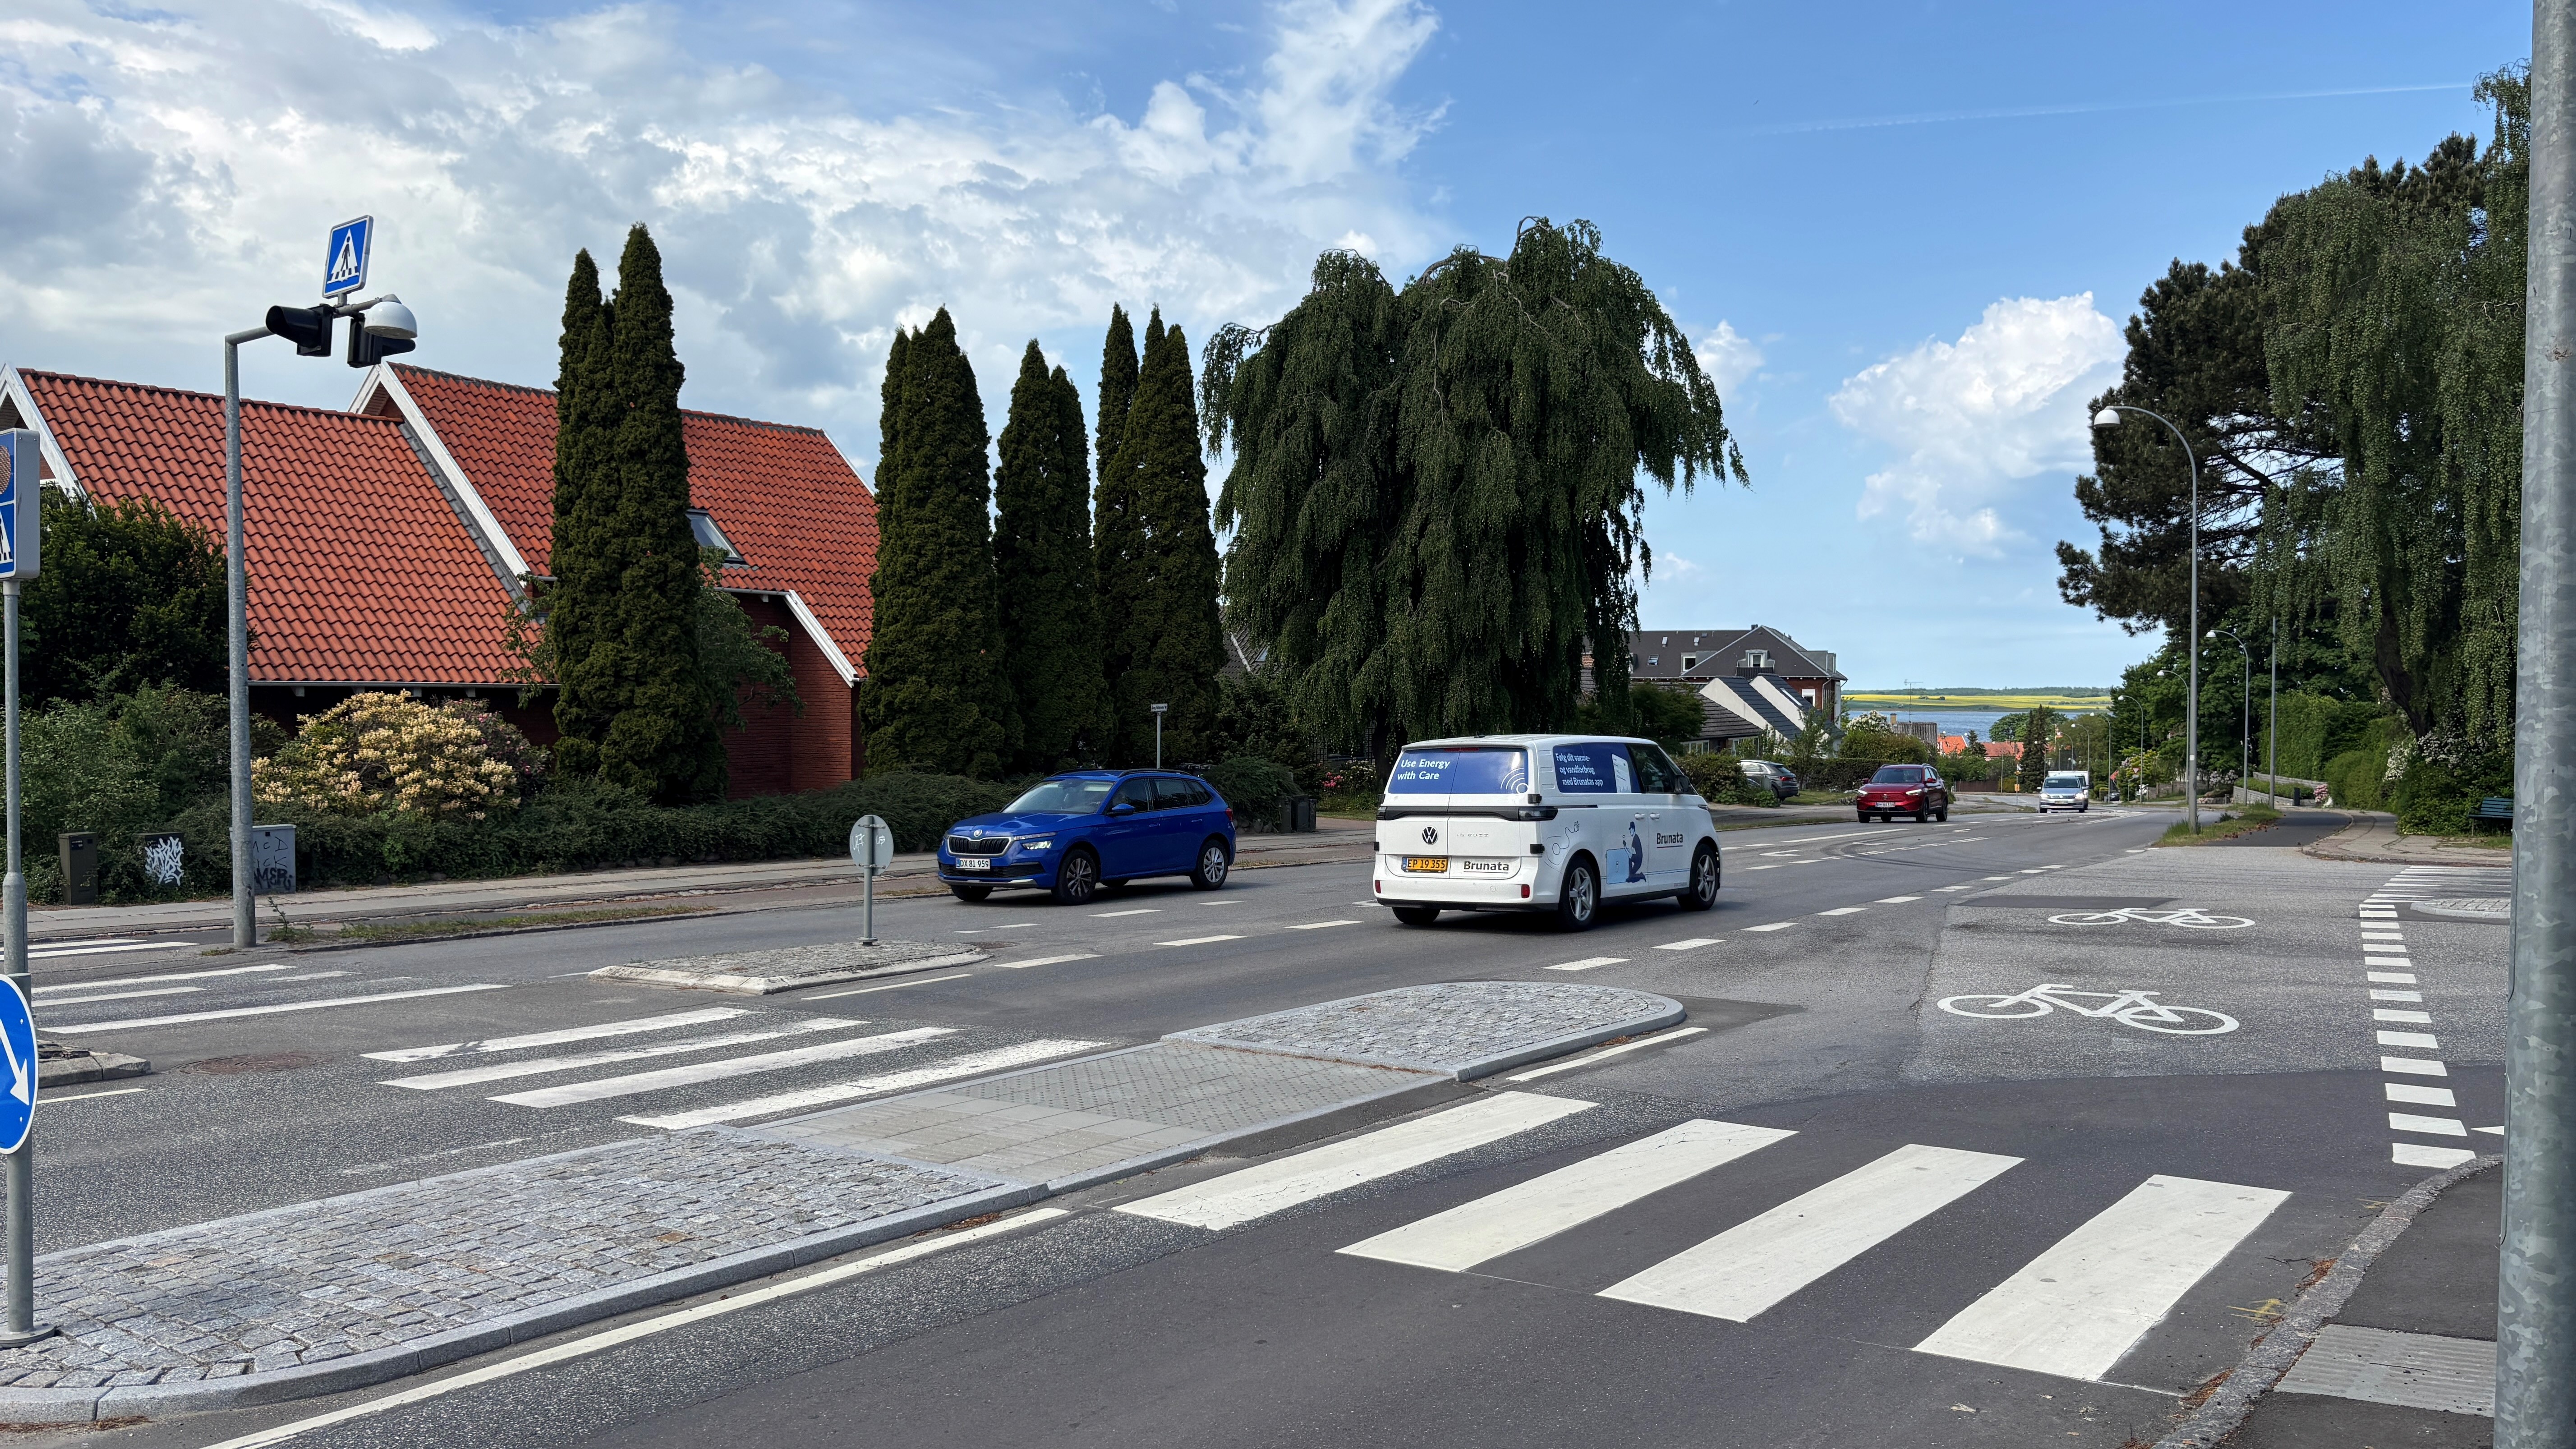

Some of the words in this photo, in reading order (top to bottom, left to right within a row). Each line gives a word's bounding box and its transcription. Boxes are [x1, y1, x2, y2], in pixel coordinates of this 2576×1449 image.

[1401, 759, 1416, 768] Use
[1419, 759, 1451, 769] Energy
[1398, 771, 1416, 780] with
[1419, 771, 1440, 780] Care
[1656, 832, 1683, 844] Brunata
[1408, 859, 1418, 868] EP
[1420, 859, 1429, 868] 19
[1431, 860, 1445, 868] 355
[1463, 861, 1509, 871] Brunata
